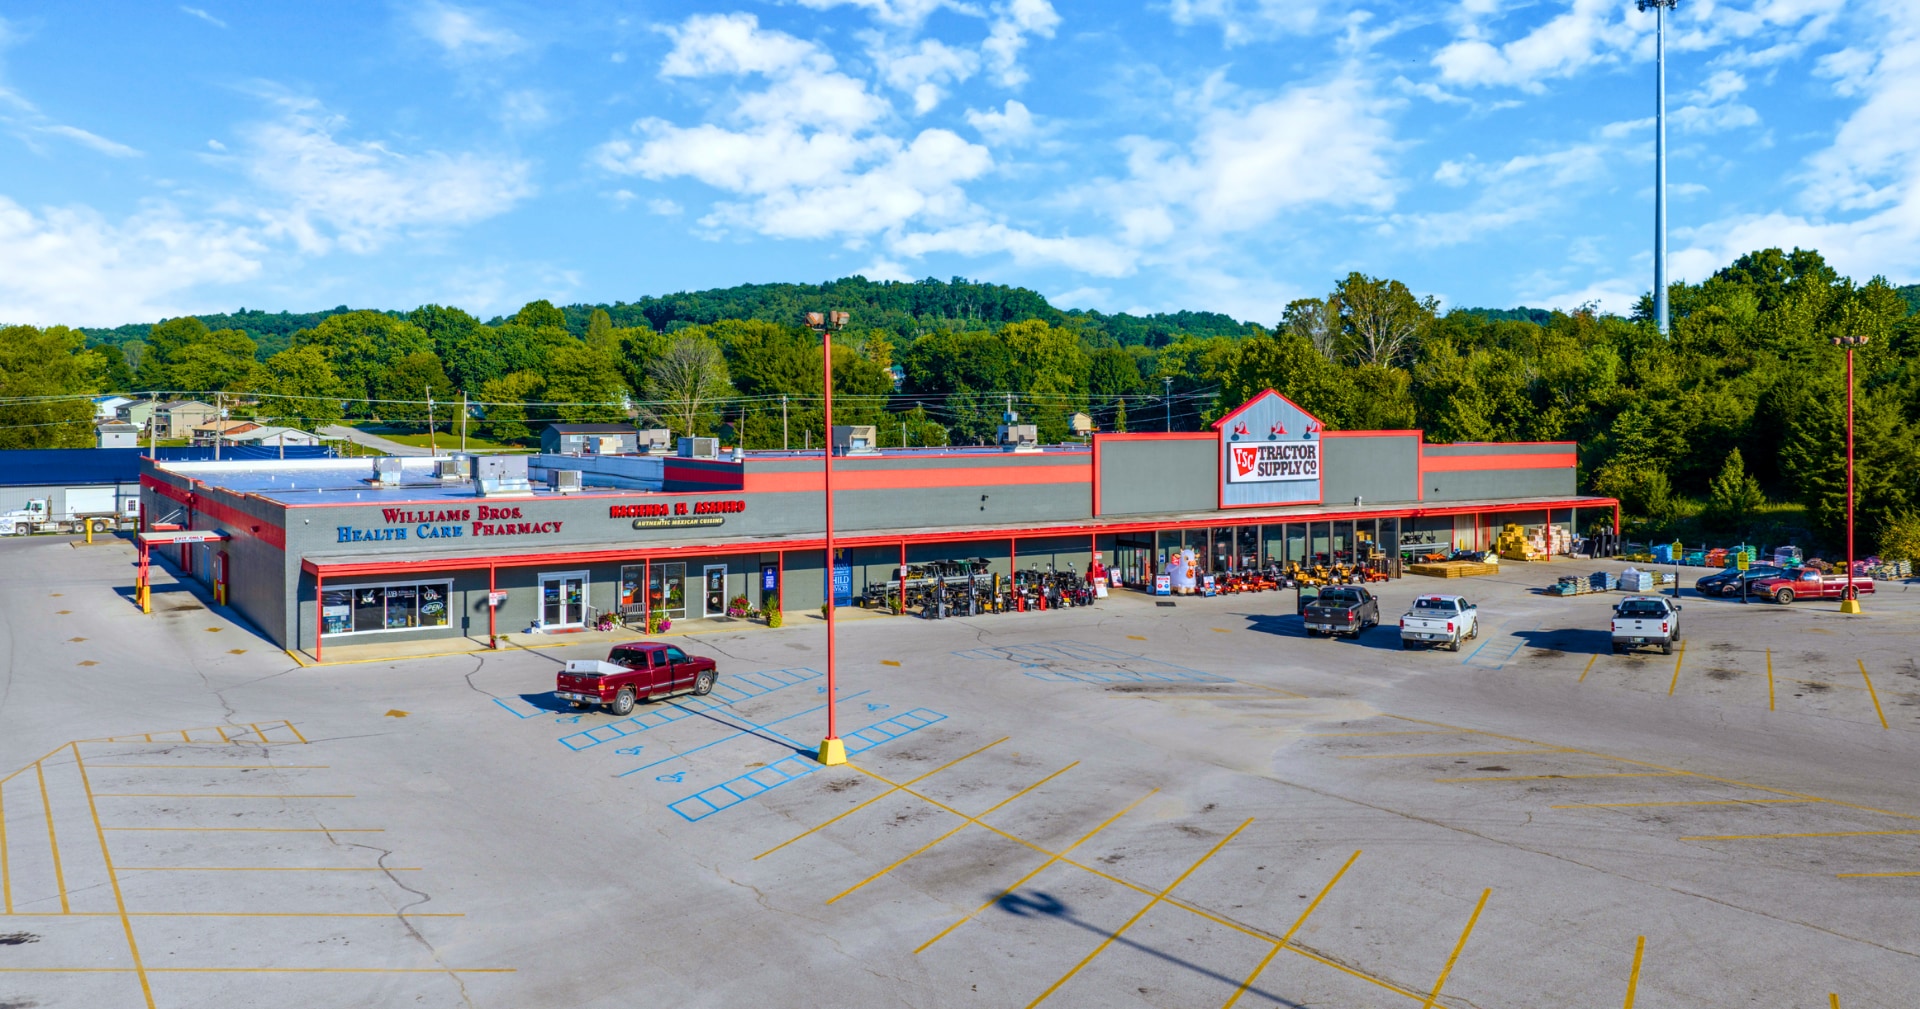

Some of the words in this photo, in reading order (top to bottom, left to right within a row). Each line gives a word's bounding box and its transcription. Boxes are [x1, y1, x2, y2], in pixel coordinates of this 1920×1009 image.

[1235, 448, 1254, 470] TSC
[1257, 445, 1316, 461] TRACTOR
[1257, 461, 1302, 477] SUPPLY
[382, 508, 470, 524] WILLIAMS
[610, 504, 669, 518] HACIENDA
[675, 502, 688, 515] EL
[694, 500, 746, 514] ASADERO
[337, 526, 407, 543] HEALTH
[416, 523, 463, 539] CARE
[472, 521, 563, 537] PHARMACY
[833, 575, 850, 585] HILD
